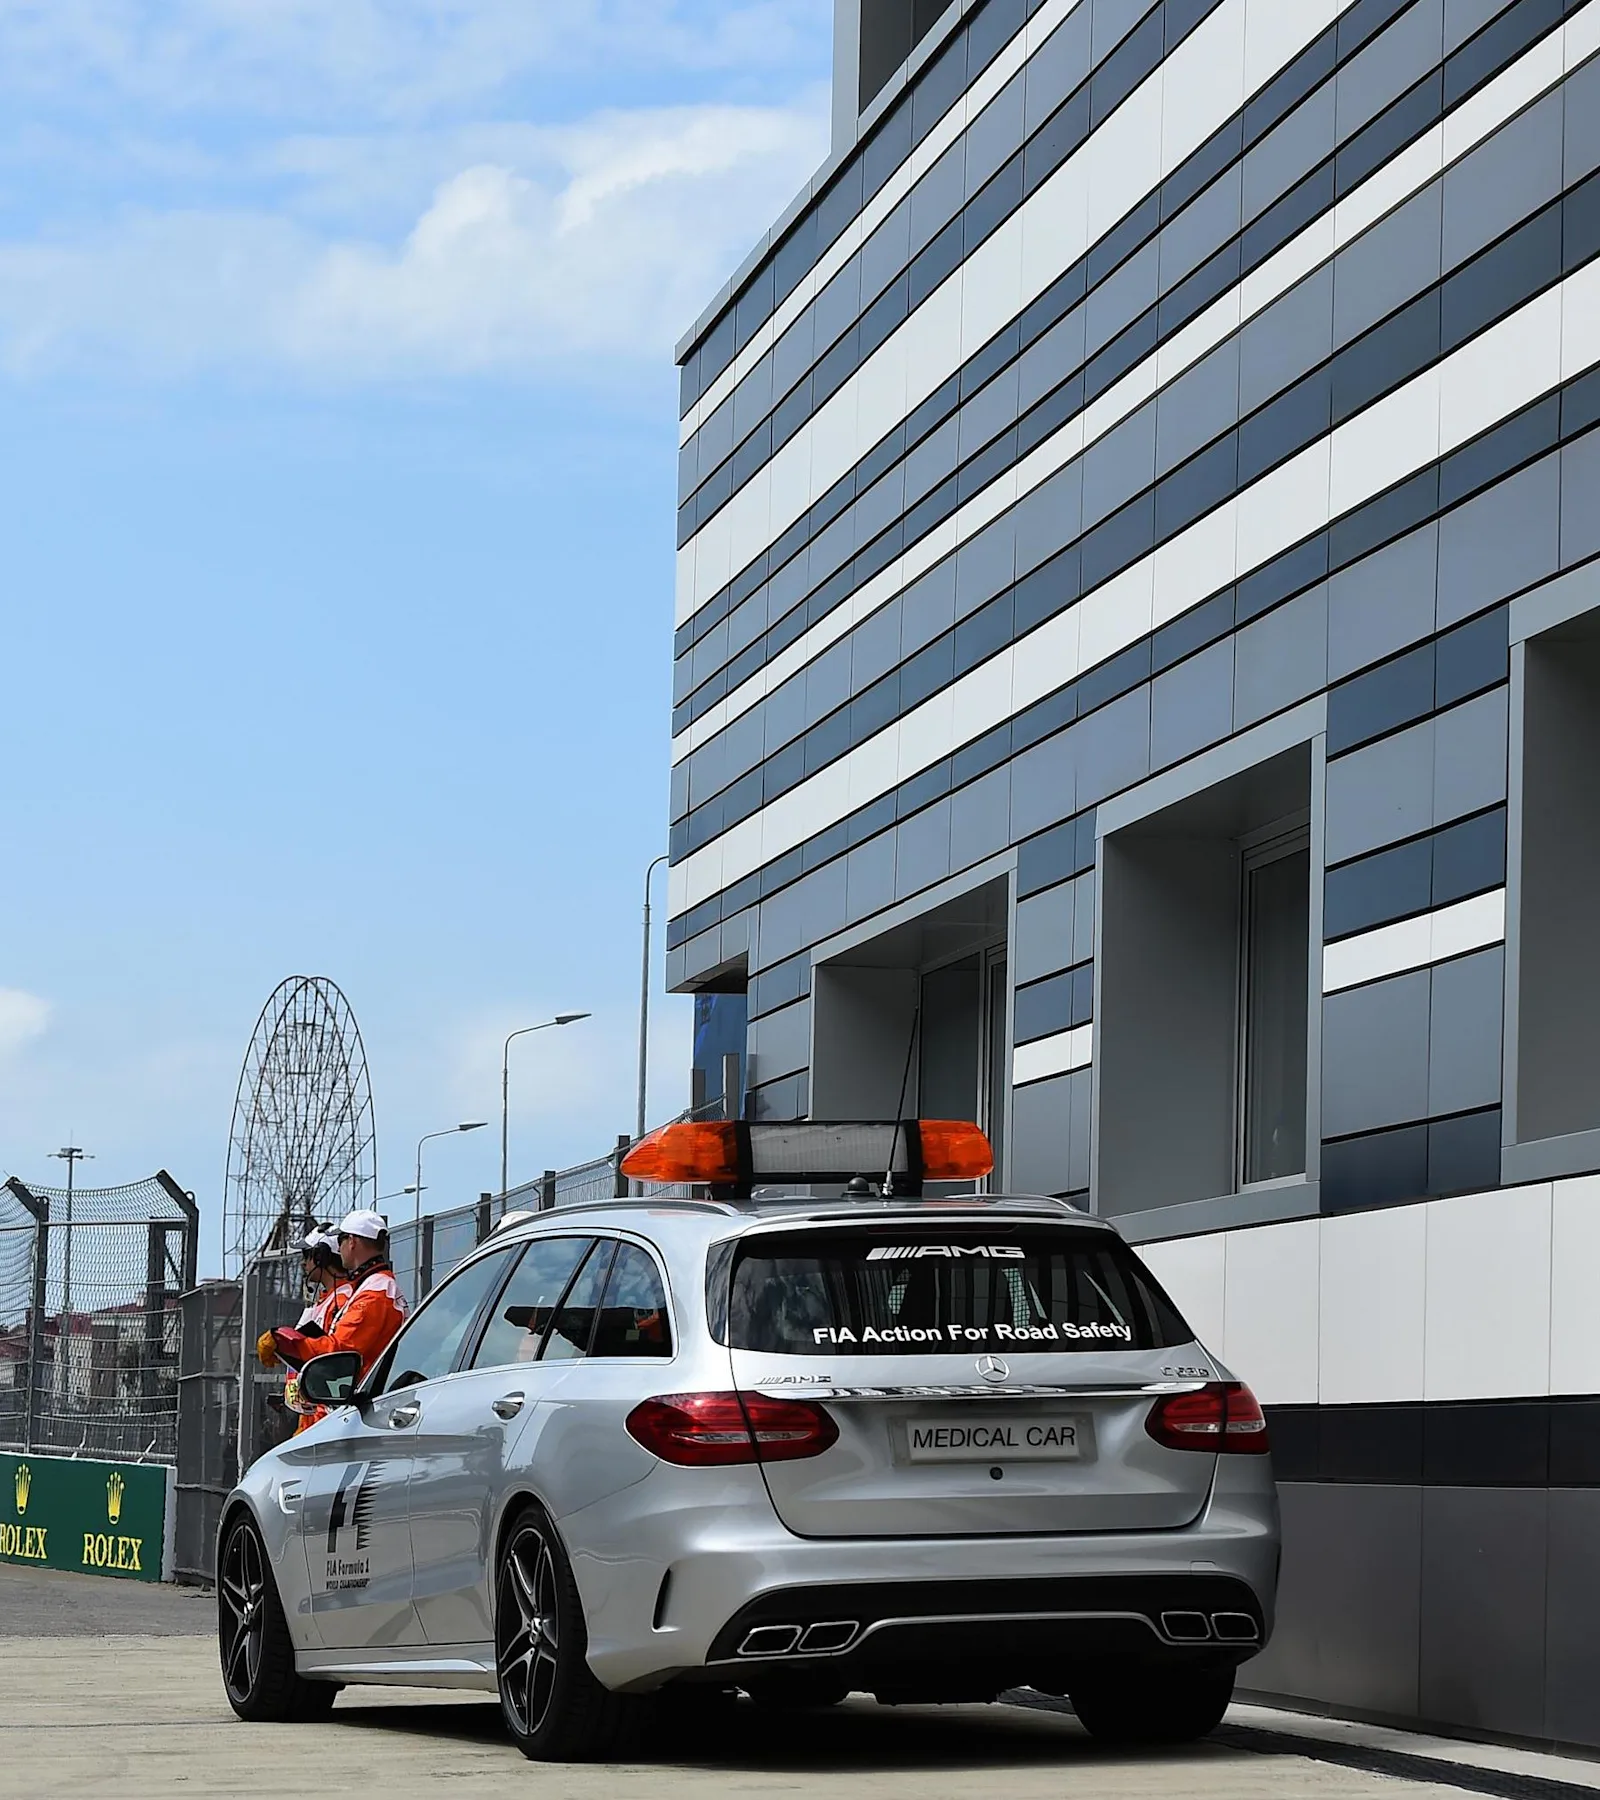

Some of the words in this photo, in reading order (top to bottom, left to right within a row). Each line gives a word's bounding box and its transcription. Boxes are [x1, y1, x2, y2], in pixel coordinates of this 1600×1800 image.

[812, 1326, 857, 1345] FIA
[862, 1324, 943, 1343] Action
[947, 1324, 989, 1341] For
[996, 1322, 1059, 1340] Road
[1065, 1321, 1133, 1342] Safety
[913, 1427, 1019, 1449] MEDICAL
[1026, 1426, 1076, 1447] CAR
[82, 1533, 143, 1571] ROLEX
[326, 1559, 337, 1577] FIA
